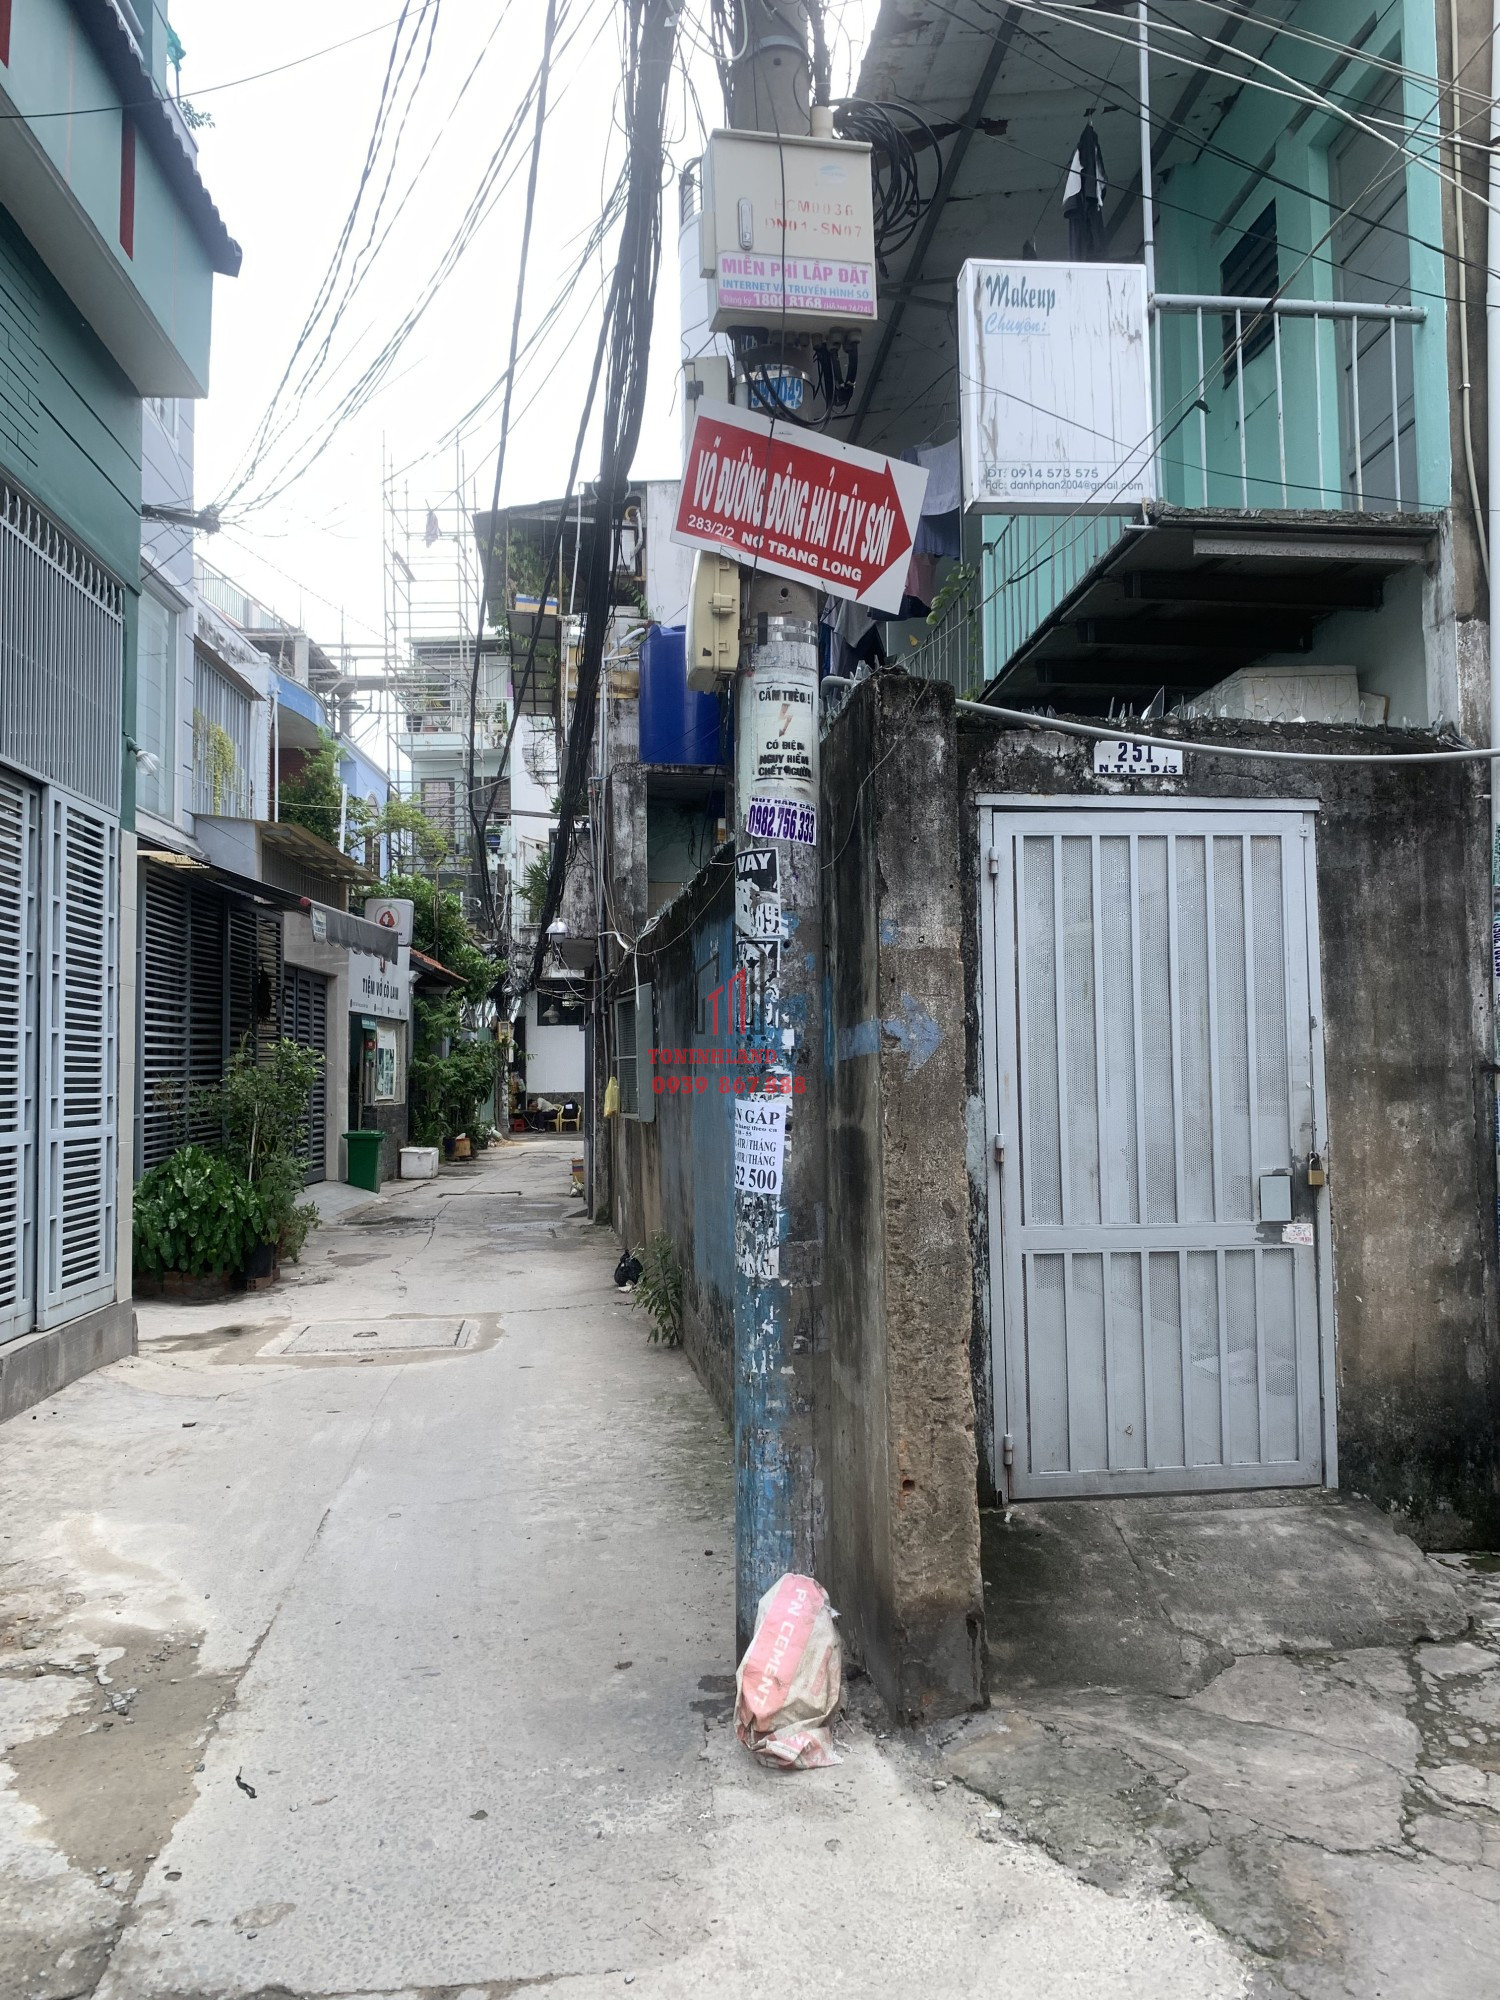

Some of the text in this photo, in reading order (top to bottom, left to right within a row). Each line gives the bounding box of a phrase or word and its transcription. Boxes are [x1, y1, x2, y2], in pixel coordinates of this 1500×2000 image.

[721, 254, 765, 276] MIỄN
[770, 260, 798, 280] PHÍ
[838, 265, 869, 287] ĐẶT
[722, 279, 770, 292] INTERNET
[985, 273, 1056, 317] Makeup
[1011, 468, 1043, 478] 0914
[1047, 468, 1071, 478] 573
[1075, 468, 1099, 478] 575
[693, 435, 721, 511] VÕ
[764, 462, 810, 541] ĐÔNG
[804, 466, 837, 548] HẢI
[832, 483, 867, 557] TÂY
[860, 496, 896, 567] SƠN
[687, 514, 735, 541] 283/2/2
[768, 539, 819, 568] TRANG
[821, 558, 862, 582] LONG
[758, 686, 781, 702] CẤM
[766, 739, 779, 750] CÓ
[1118, 742, 1154, 763] 251
[759, 754, 785, 765] NGUY
[747, 805, 815, 844] 0982.756.333
[737, 852, 772, 873] VAY
[745, 1107, 780, 1125] GẤP
[748, 1168, 777, 1190] 500
[752, 1621, 796, 1709] CEMENT
